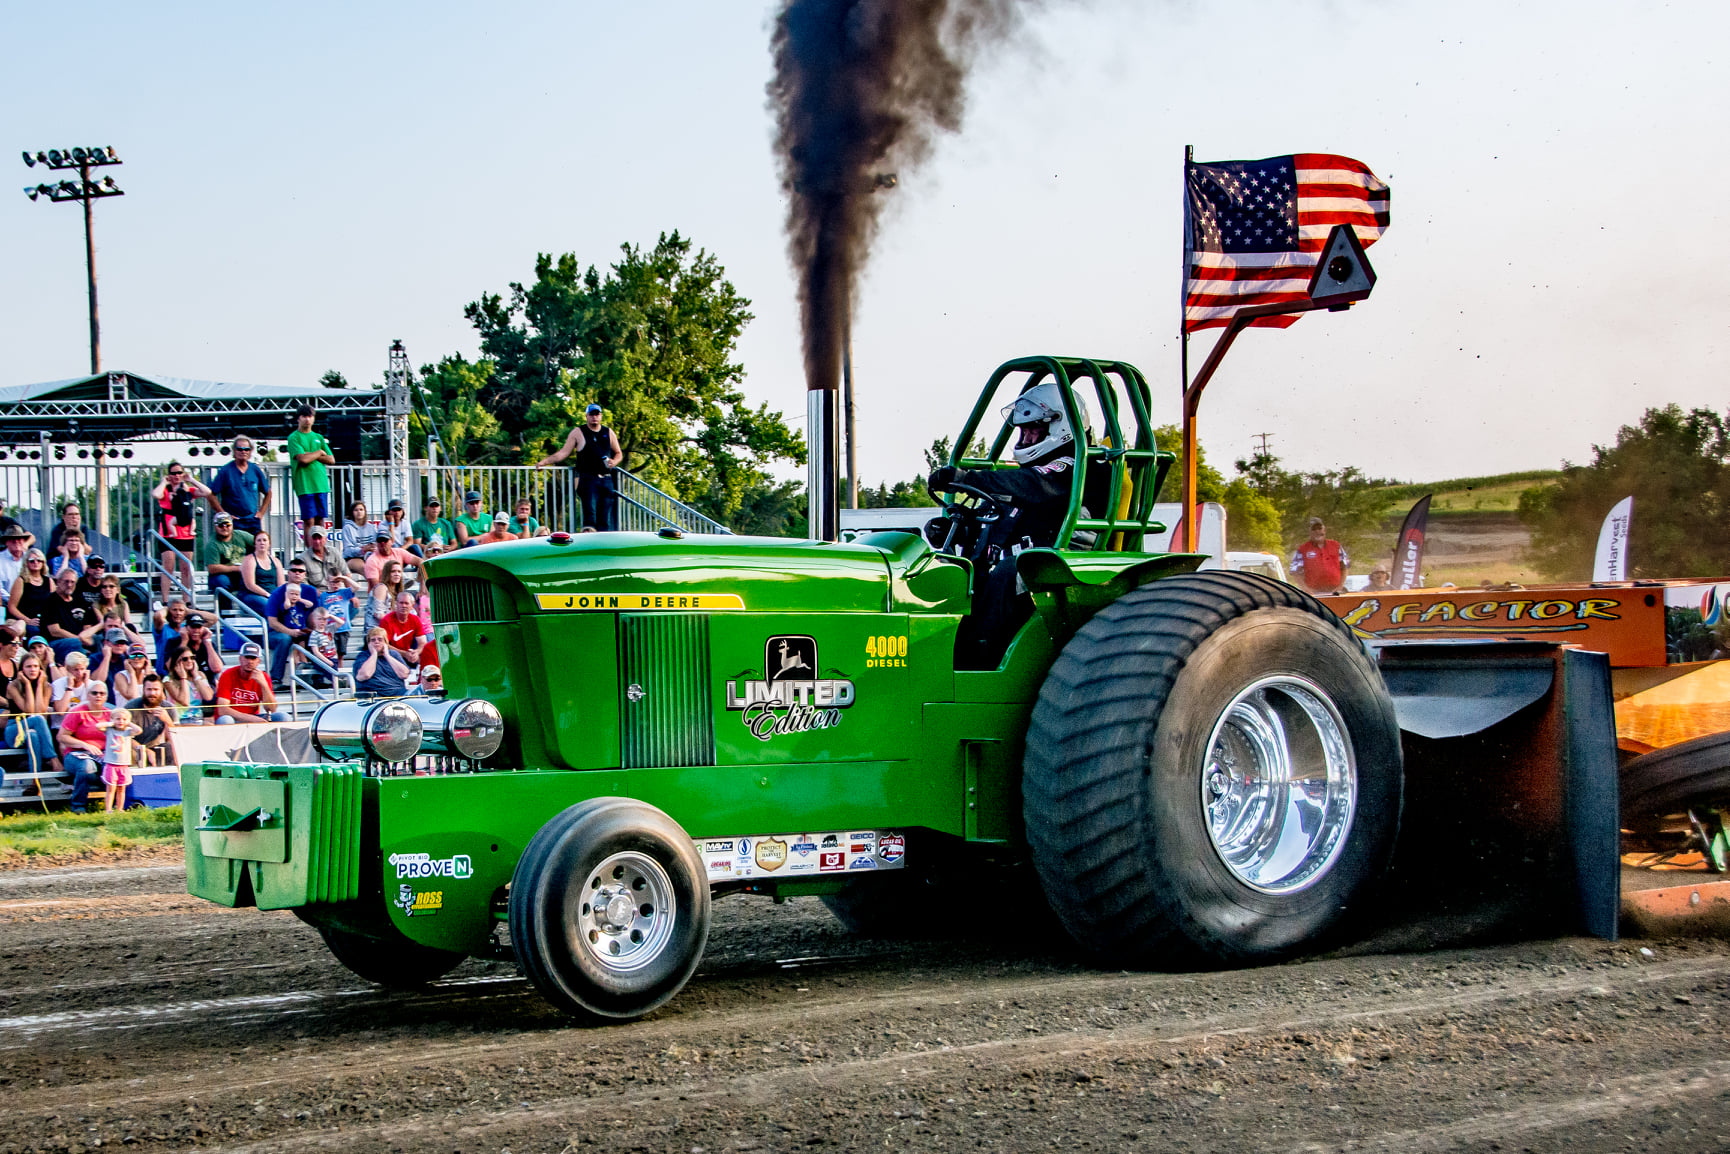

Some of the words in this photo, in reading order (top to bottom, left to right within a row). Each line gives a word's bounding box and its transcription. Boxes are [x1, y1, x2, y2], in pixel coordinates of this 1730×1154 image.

[565, 597, 618, 607] JOHN
[641, 597, 699, 607] DEERE
[1389, 599, 1621, 623] FACTOR
[865, 636, 907, 657] 4000
[867, 659, 907, 667] DIESEL
[726, 679, 855, 711] LIMITED
[742, 700, 842, 741] Edition
[398, 857, 469, 876] PROVEN
[416, 891, 442, 905] ROSS
